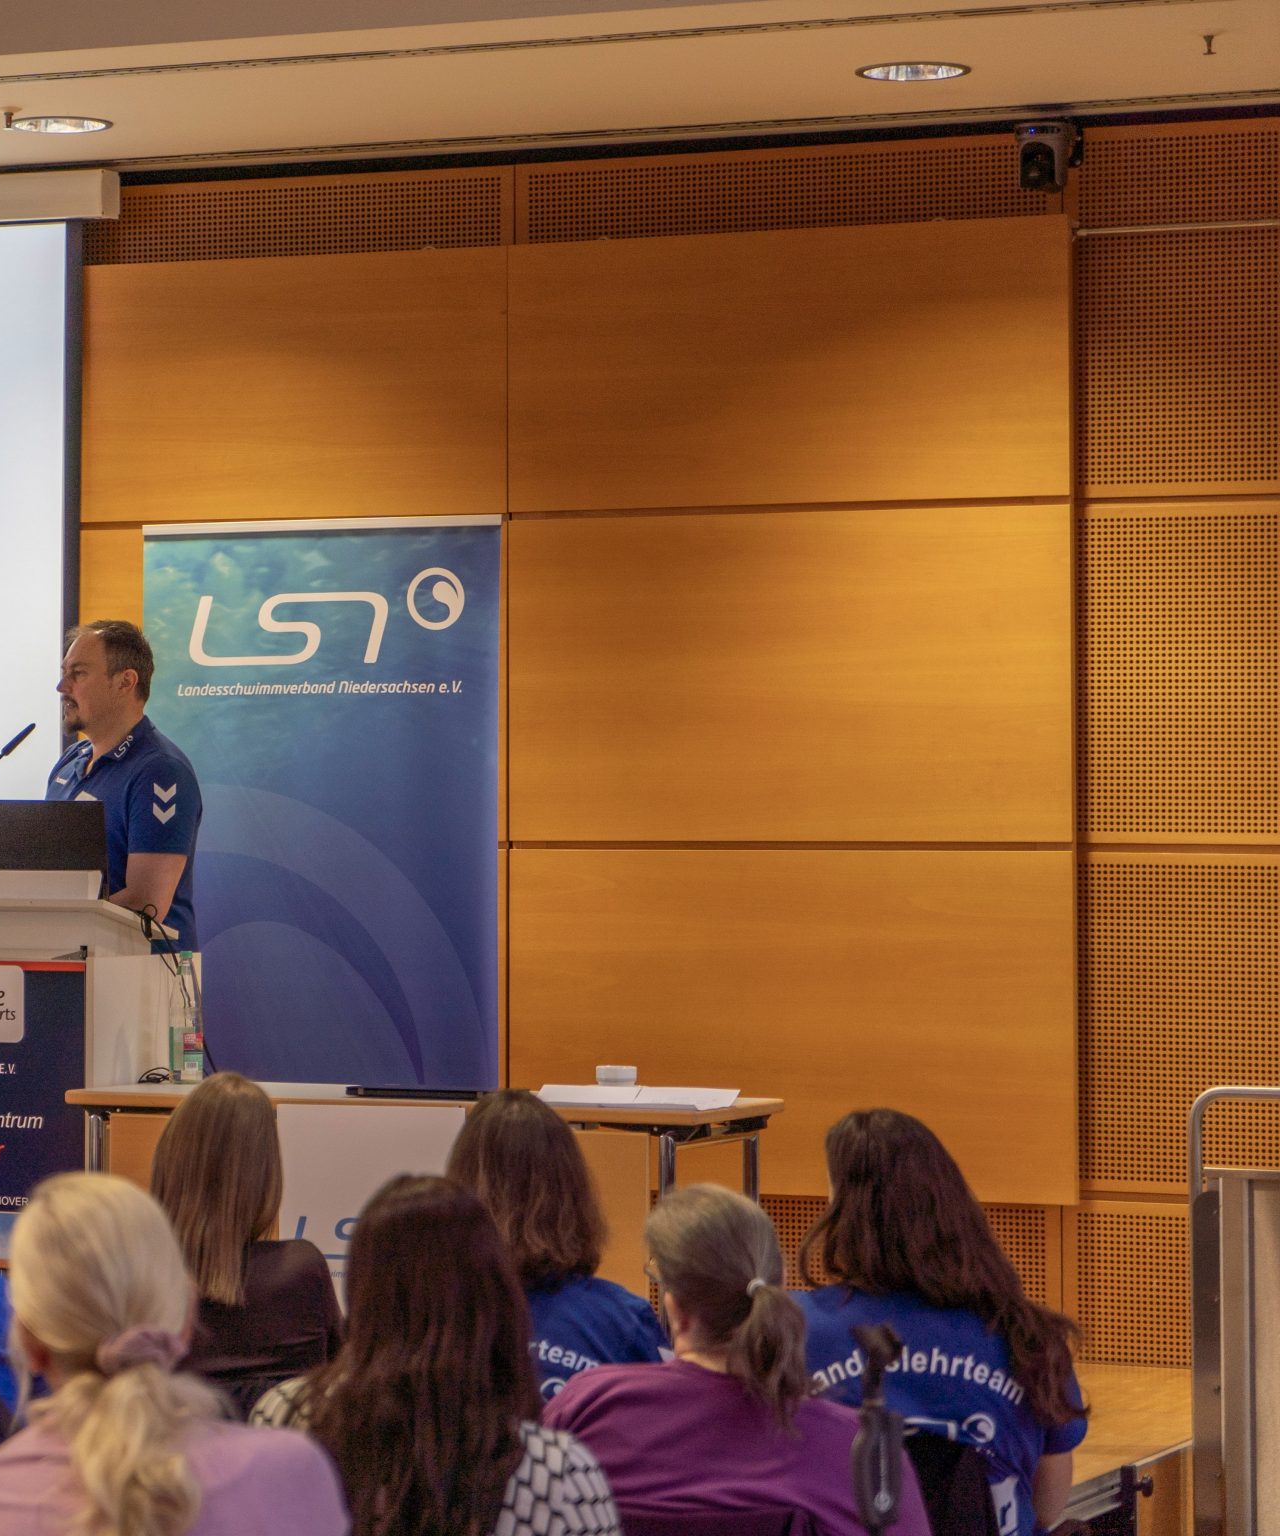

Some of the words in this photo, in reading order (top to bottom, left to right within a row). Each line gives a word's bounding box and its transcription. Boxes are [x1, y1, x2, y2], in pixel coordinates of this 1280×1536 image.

[177, 681, 335, 697] Landesschwimmverband
[337, 680, 436, 696] Niedersachsen
[810, 1345, 1026, 1406] andlehrteam
